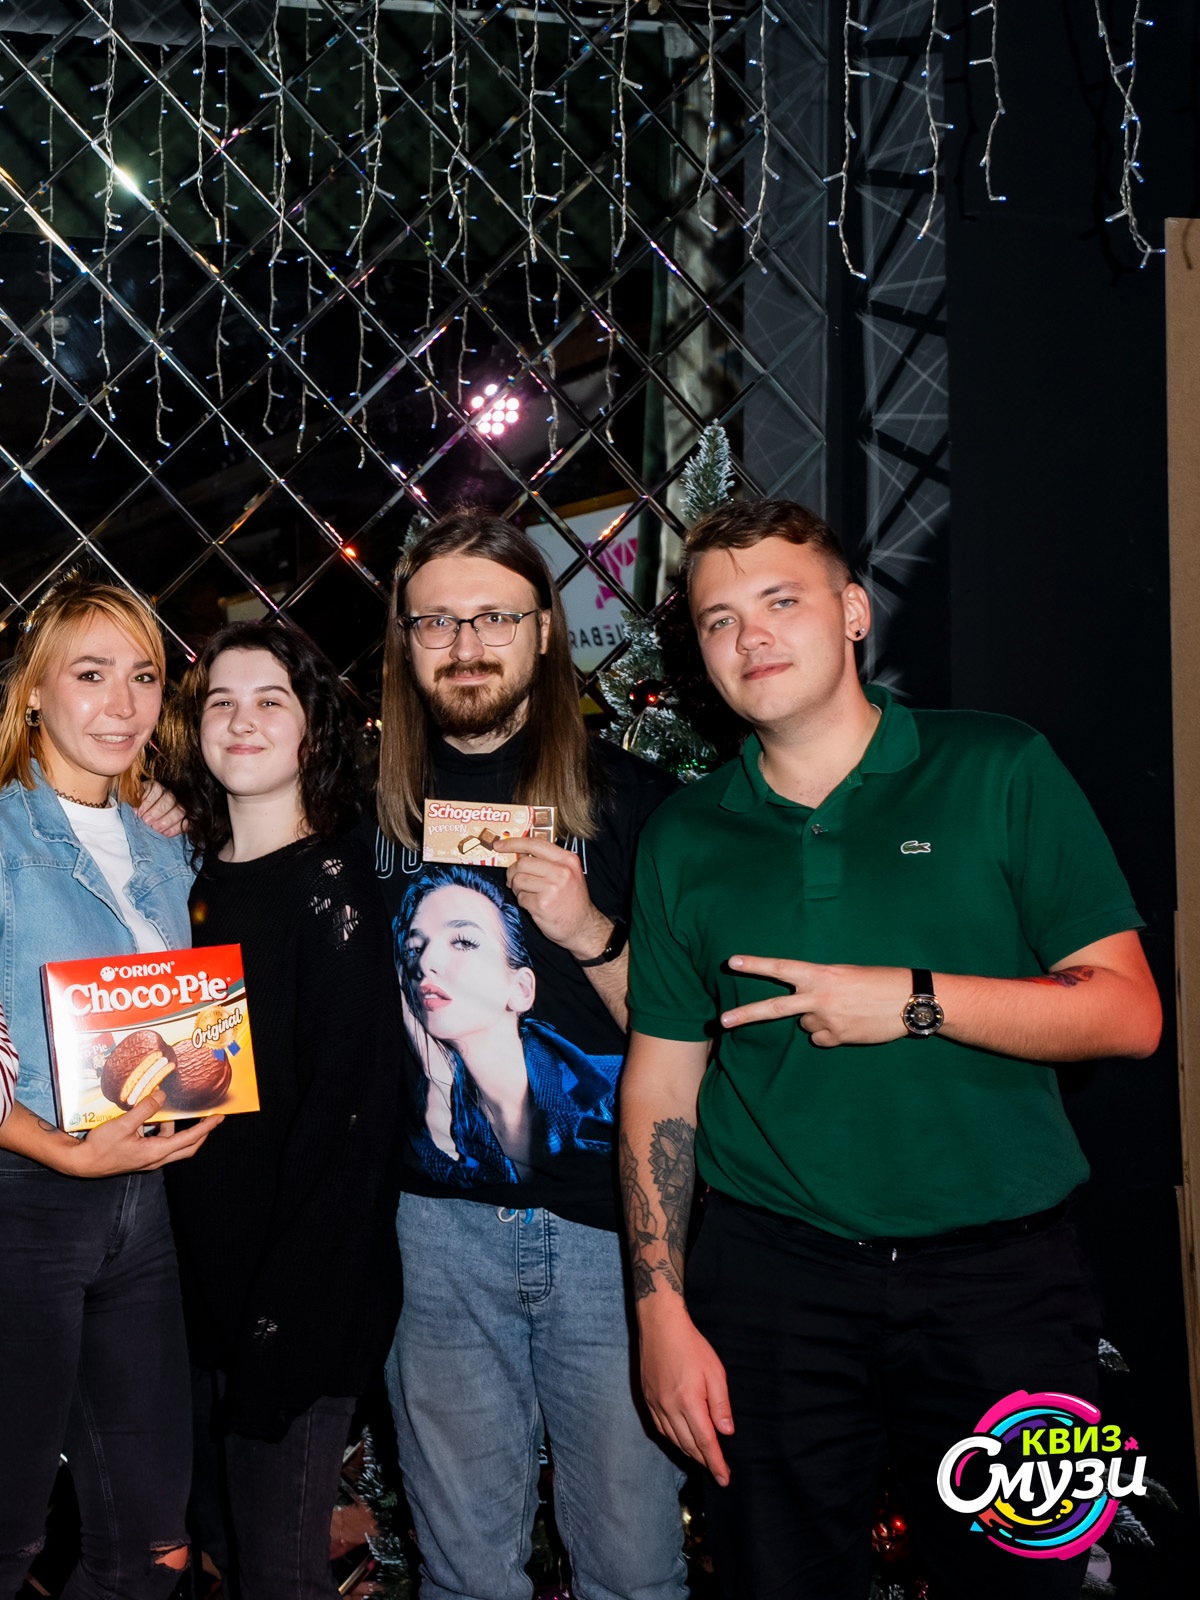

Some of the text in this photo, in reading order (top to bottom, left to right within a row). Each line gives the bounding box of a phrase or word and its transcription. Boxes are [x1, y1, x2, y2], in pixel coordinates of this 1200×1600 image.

[428, 803, 511, 823] Schogetten
[428, 823, 468, 836] POPCORN
[192, 1008, 243, 1048] Original
[82, 1111, 96, 1123] 12
